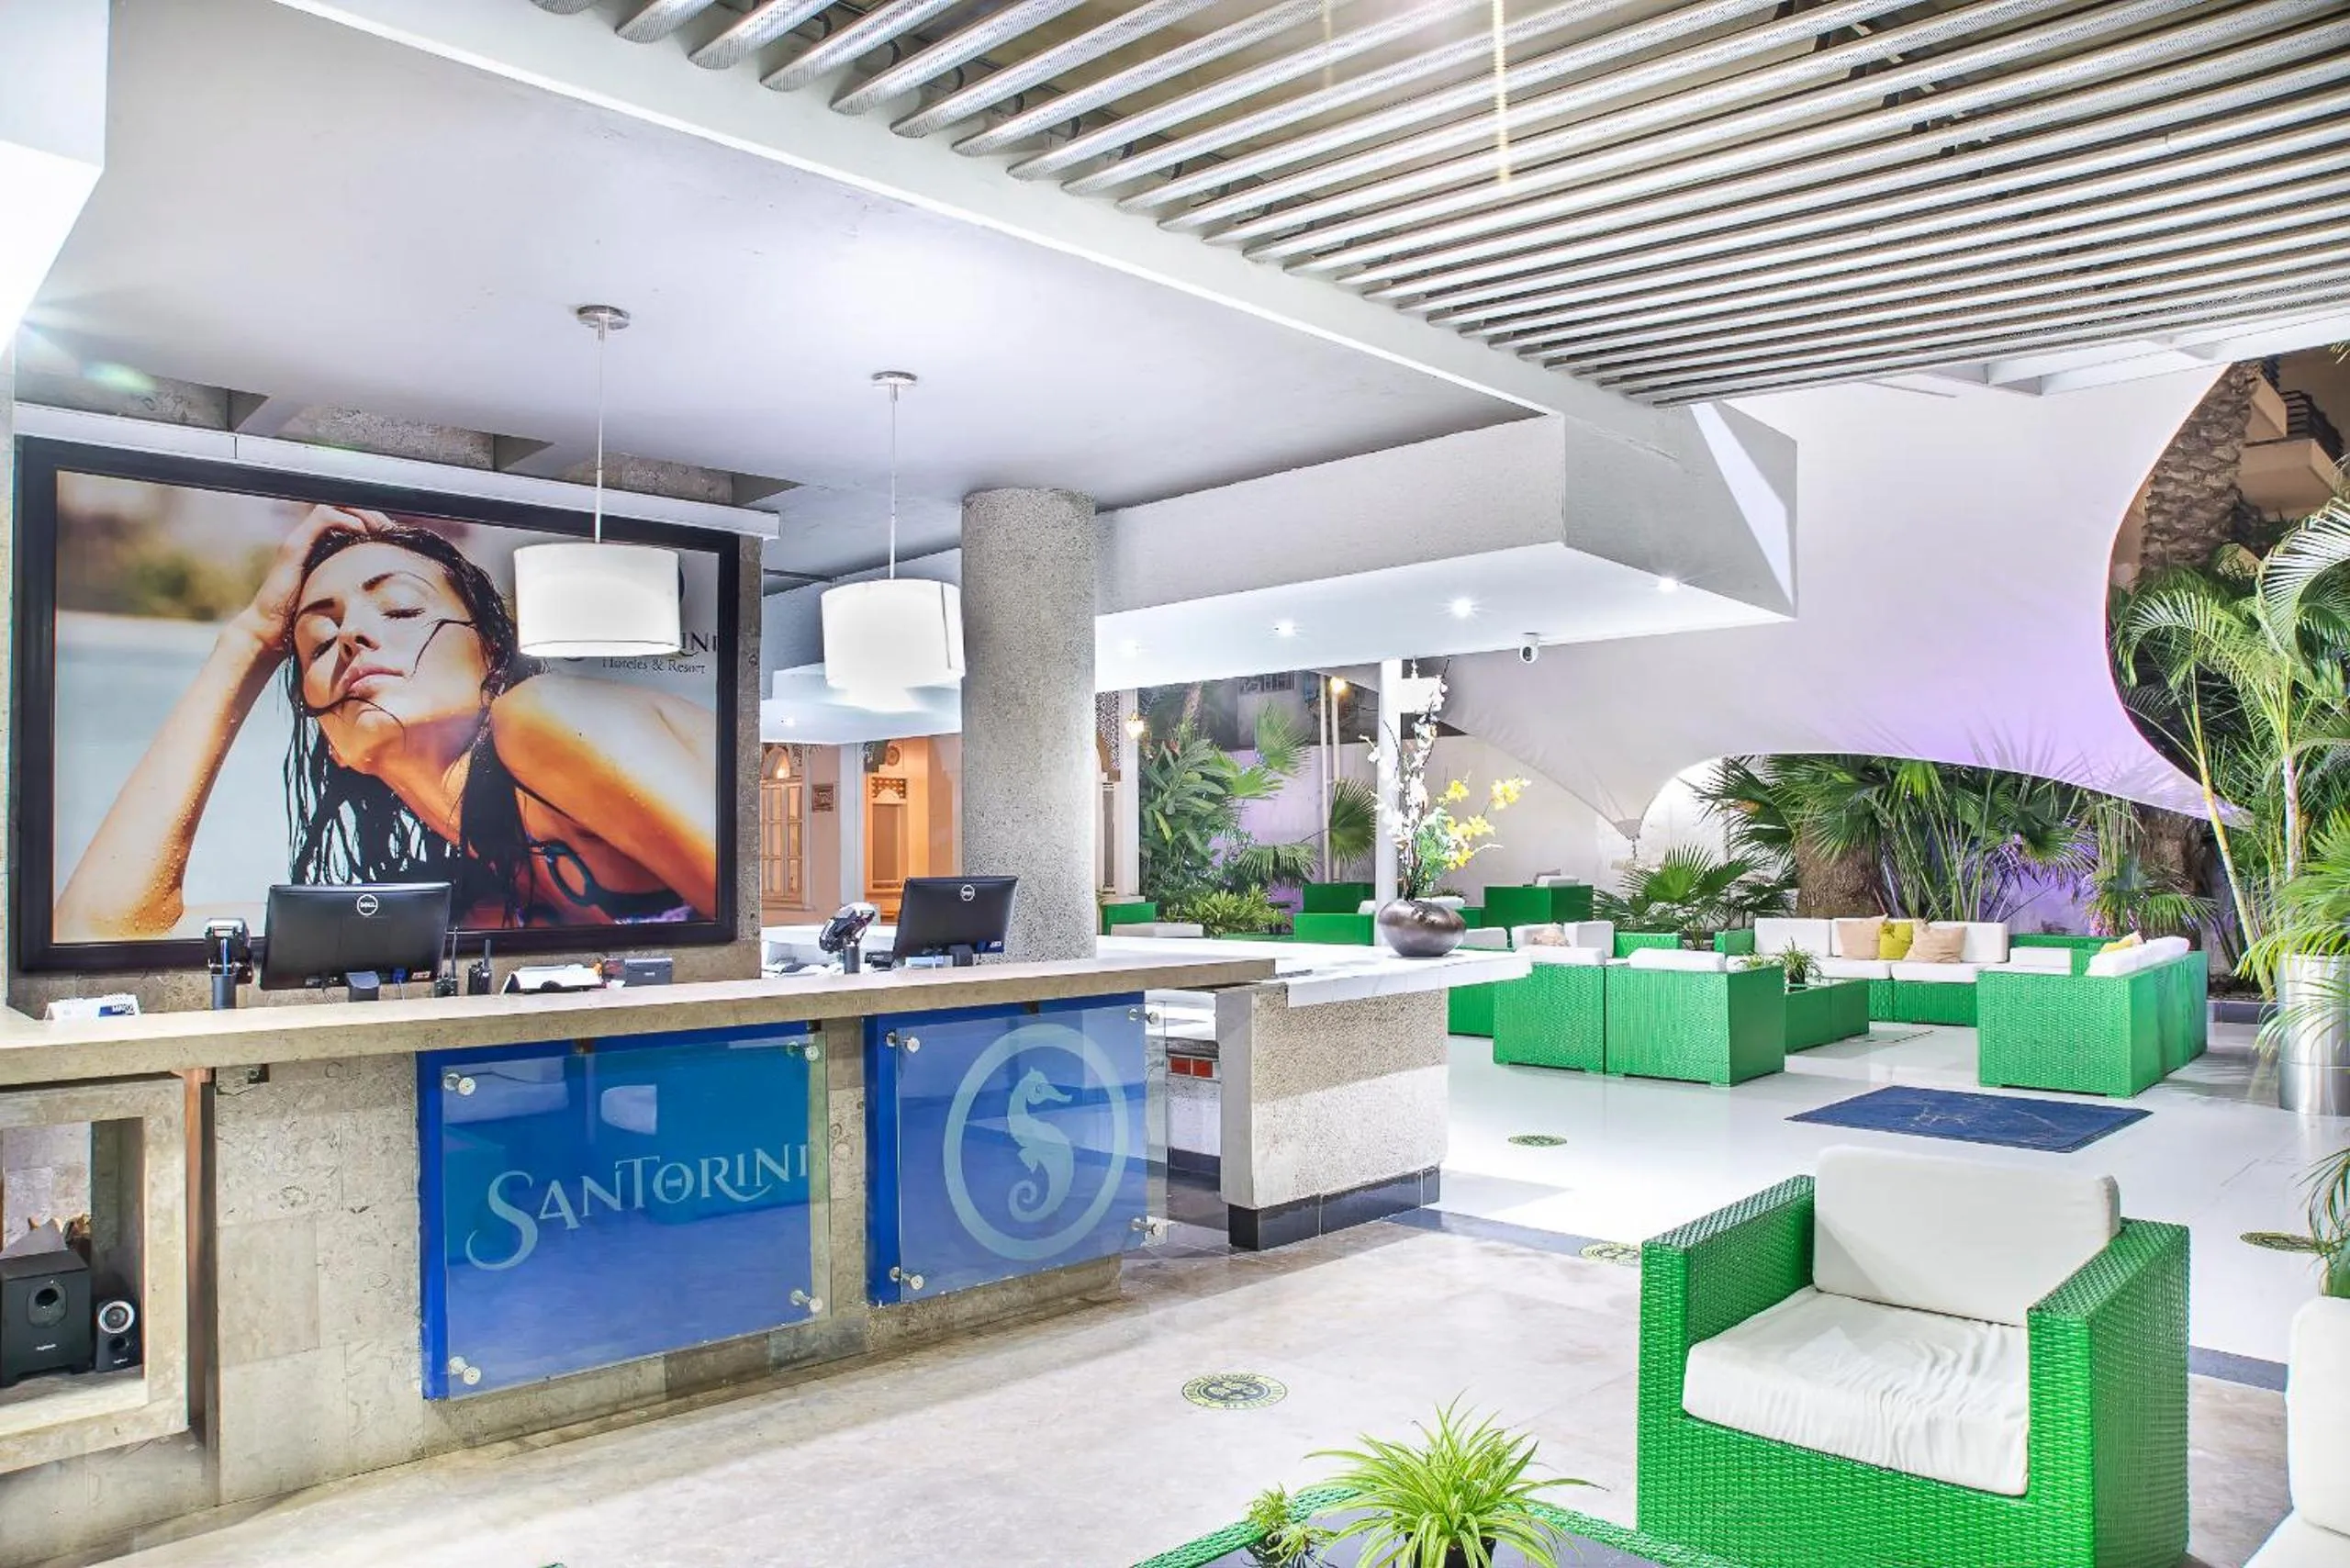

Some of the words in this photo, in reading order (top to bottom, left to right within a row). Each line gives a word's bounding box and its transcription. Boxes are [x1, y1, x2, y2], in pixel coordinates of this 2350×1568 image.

[602, 657, 648, 670] Hoteles
[652, 659, 663, 671] &
[464, 1144, 808, 1271] SANTORINI
